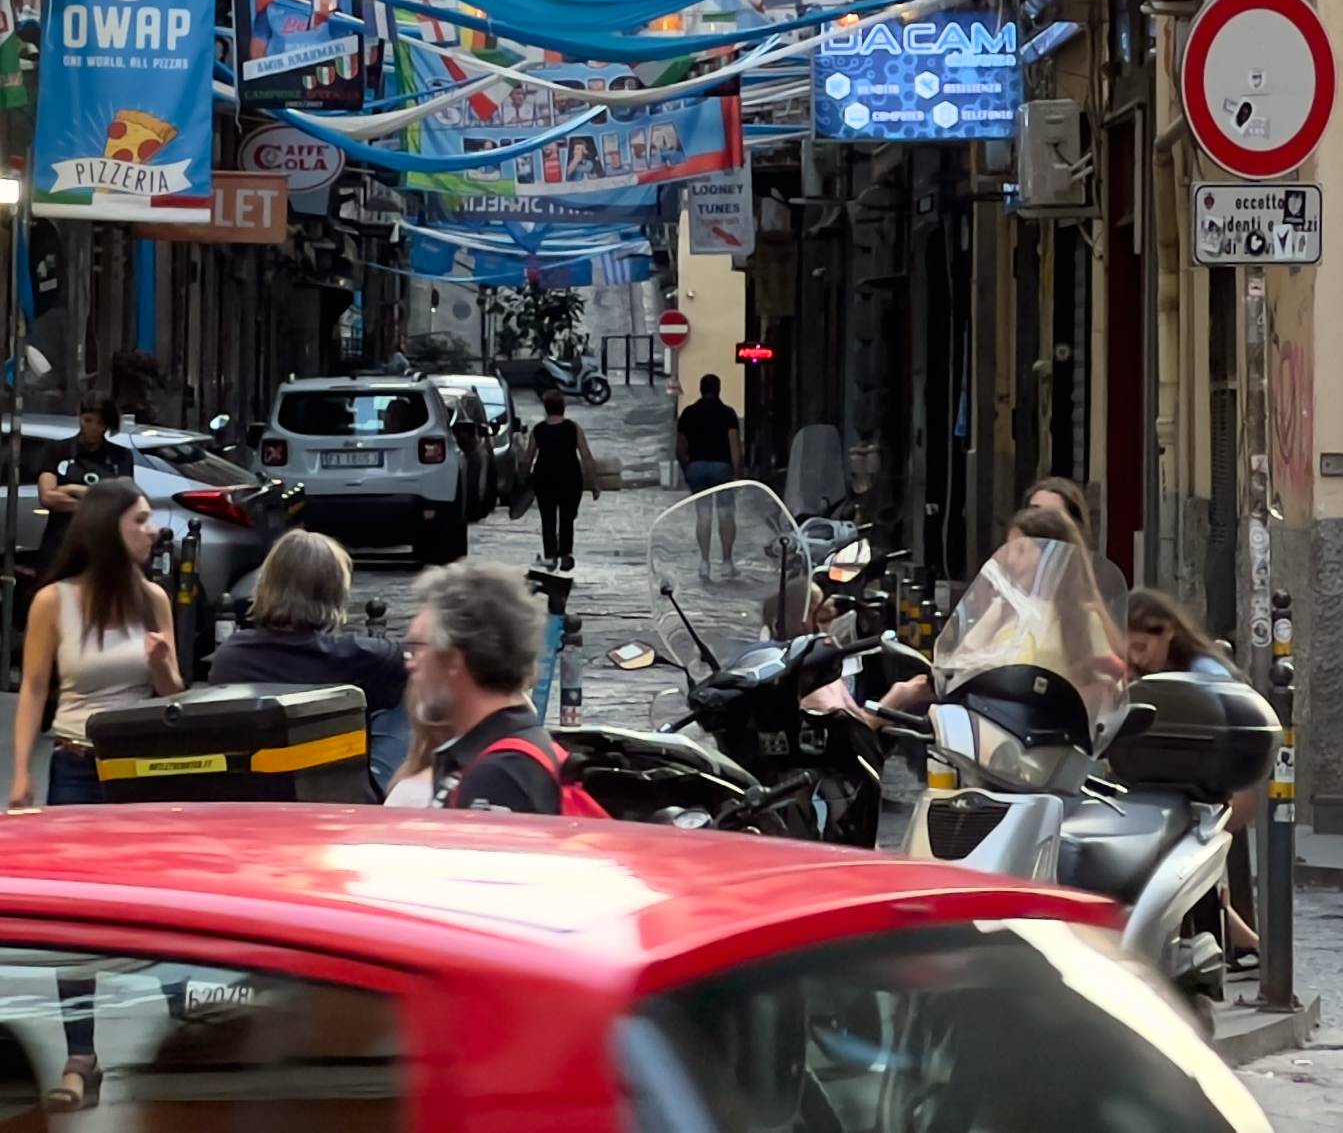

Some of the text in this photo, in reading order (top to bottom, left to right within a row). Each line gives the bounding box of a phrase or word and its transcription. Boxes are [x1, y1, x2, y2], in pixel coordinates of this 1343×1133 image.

[63, 5, 191, 50] OWAP
[820, 22, 1017, 55] DACAM
[130, 57, 147, 69] ALL
[153, 58, 189, 70] PIZZAS
[75, 161, 170, 193] PIZZERIA
[692, 185, 744, 196] LOONEY
[1235, 194, 1285, 210] eccetto
[214, 188, 279, 228] LET
[698, 203, 741, 214] TUNES
